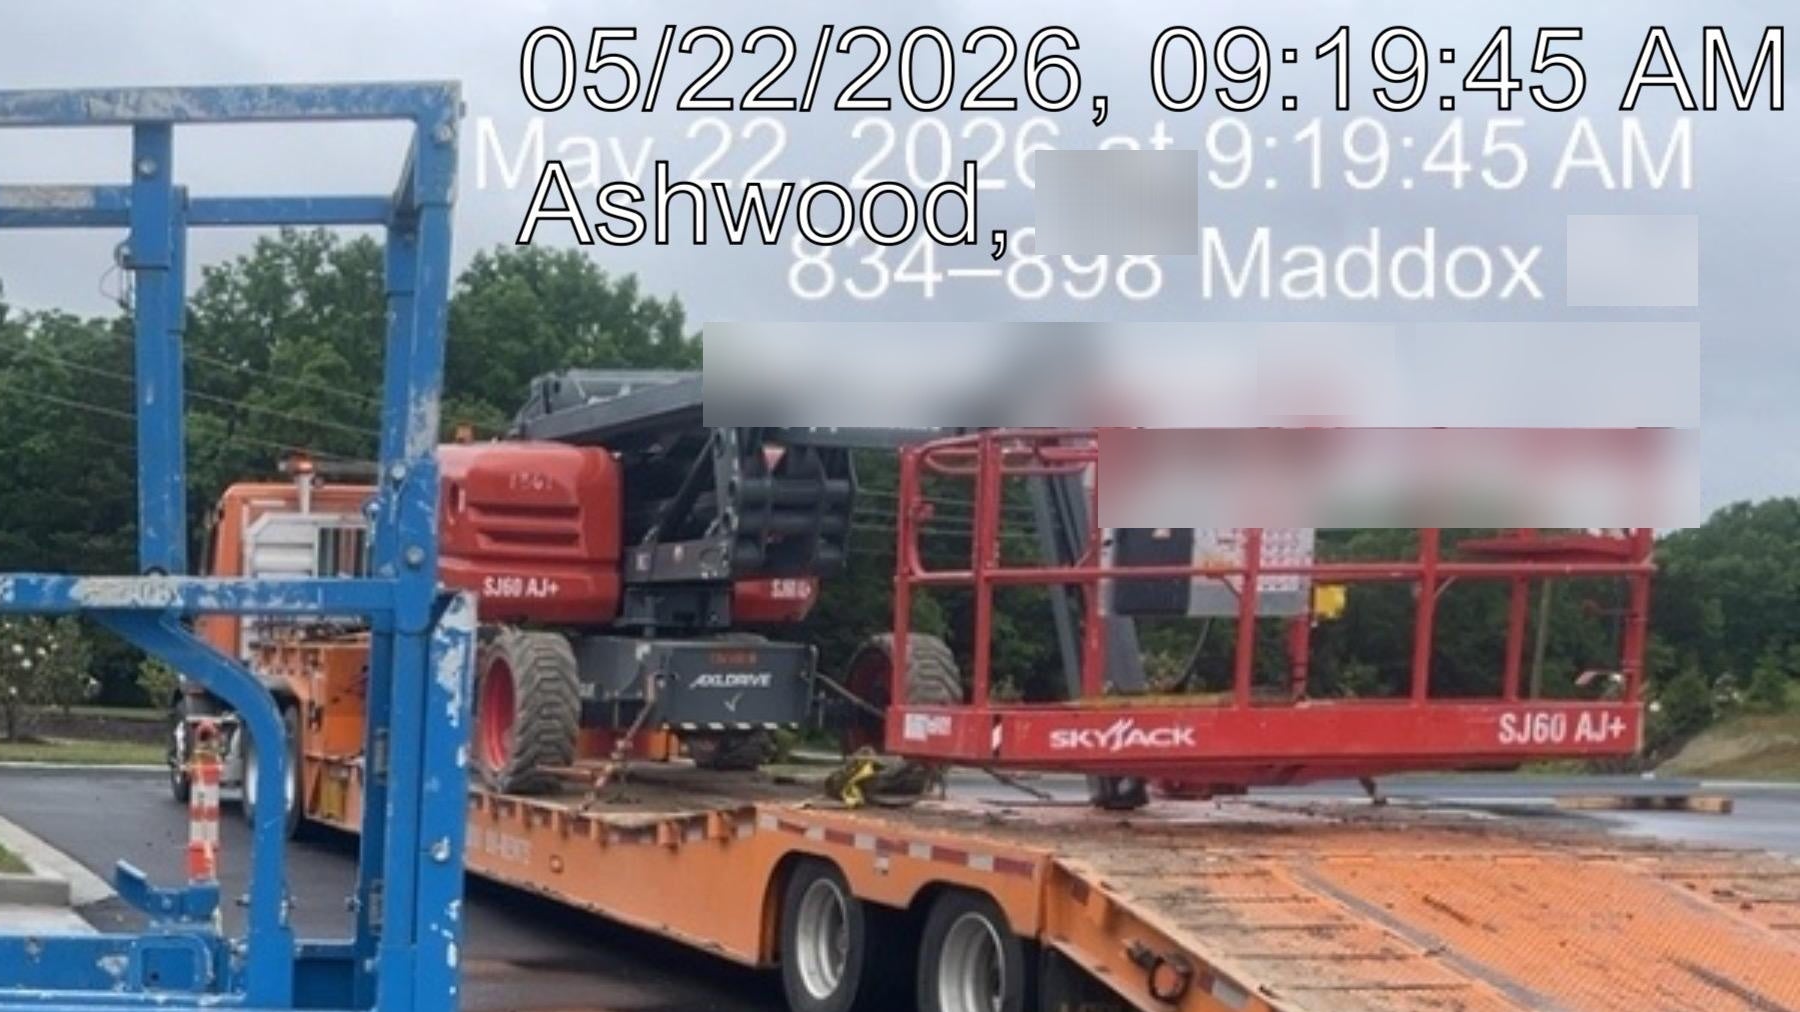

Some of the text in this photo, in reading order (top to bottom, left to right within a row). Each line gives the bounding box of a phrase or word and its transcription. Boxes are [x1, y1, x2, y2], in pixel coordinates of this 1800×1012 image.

[482, 577, 559, 598] SJ60 AJ+
[1050, 717, 1196, 752] SKYJACK
[1498, 711, 1627, 744] SJ60 AJ+
